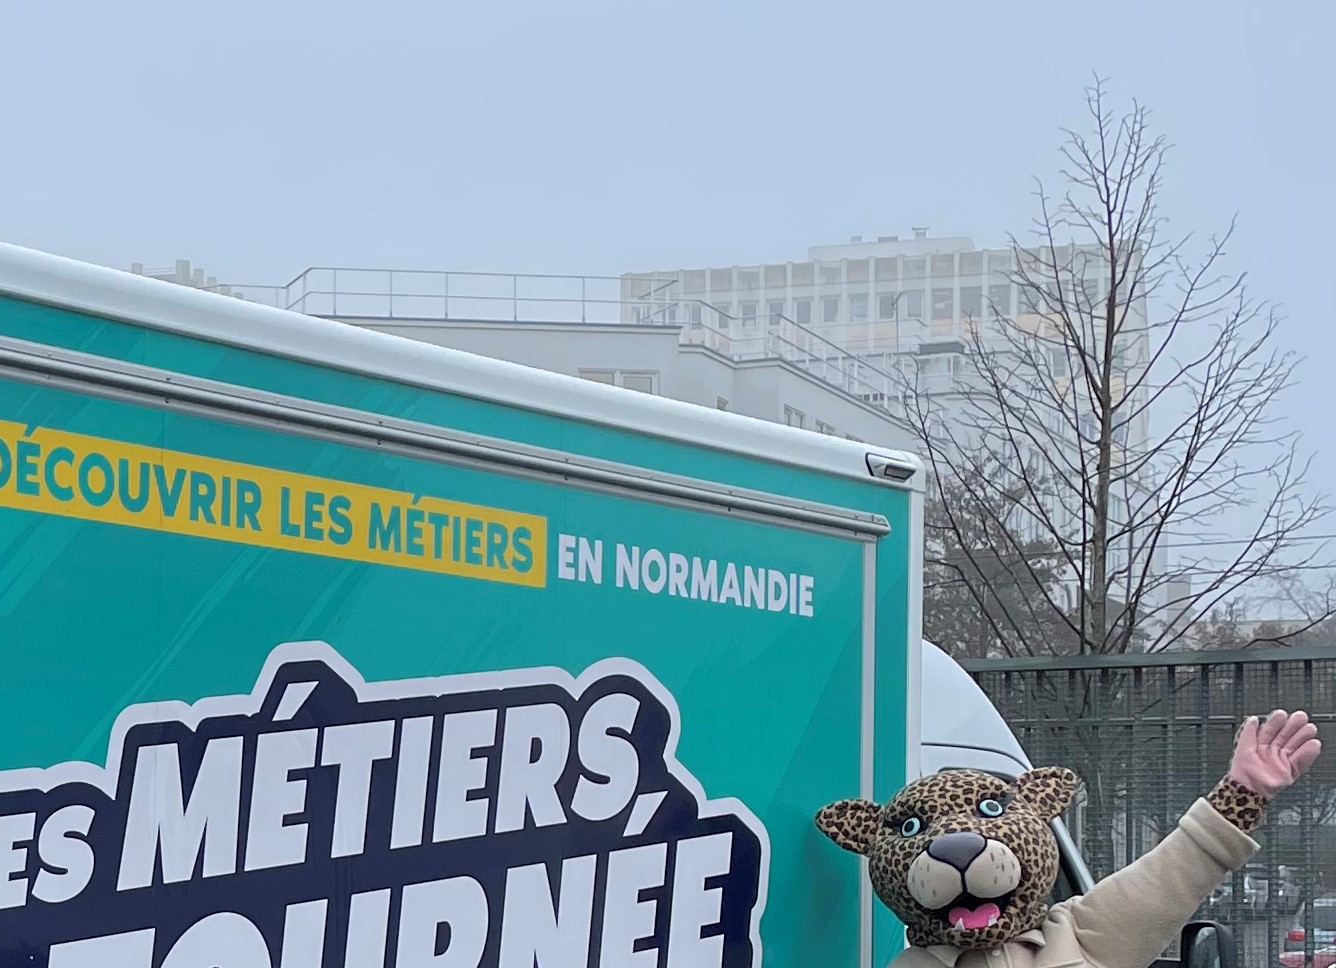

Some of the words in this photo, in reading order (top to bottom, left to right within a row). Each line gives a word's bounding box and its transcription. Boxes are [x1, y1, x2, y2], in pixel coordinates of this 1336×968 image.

[280, 485, 353, 546] LES
[368, 494, 534, 574] MÉTIERS
[557, 533, 603, 584] EN
[616, 544, 815, 617] NORMANDIE
[116, 681, 642, 892] MÉTIERS
